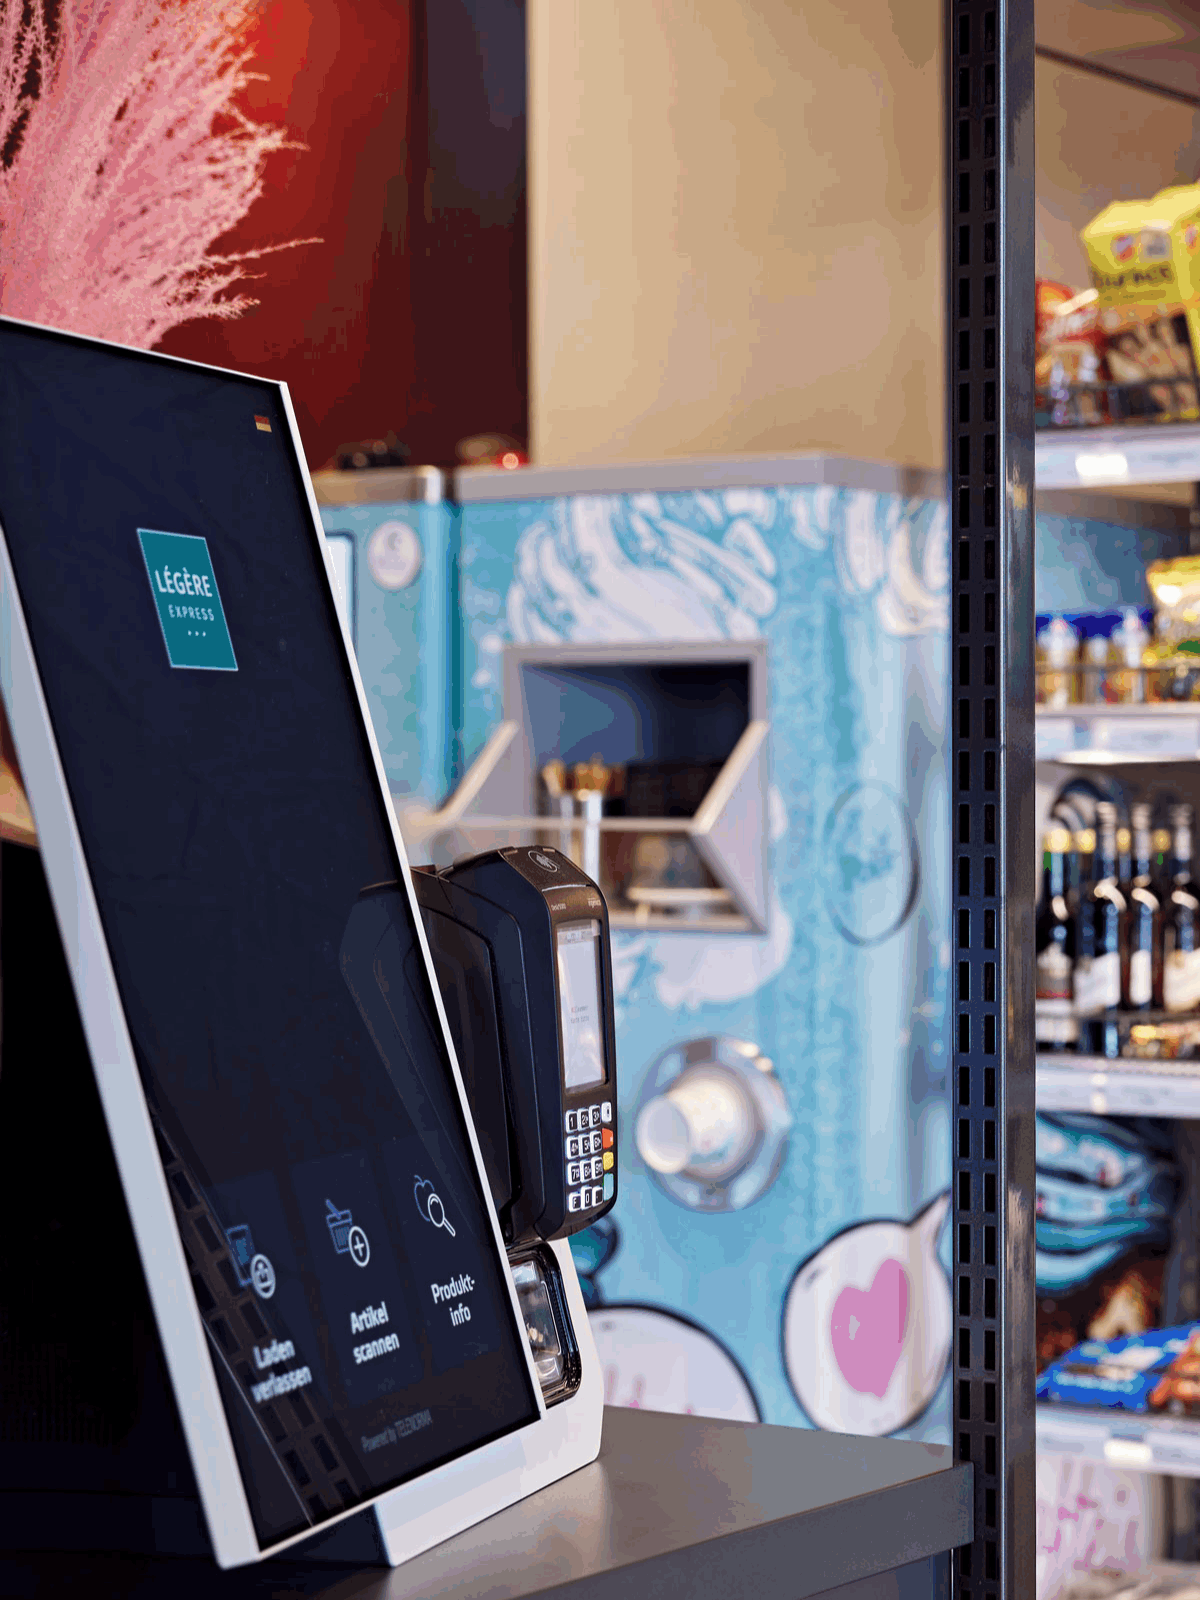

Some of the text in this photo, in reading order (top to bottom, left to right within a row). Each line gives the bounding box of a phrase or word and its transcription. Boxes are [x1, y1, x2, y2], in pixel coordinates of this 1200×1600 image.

[155, 565, 213, 597] LÉGÈRE
[168, 604, 215, 621] EXPRESS
[431, 1273, 475, 1304] Produkt-
[350, 1300, 389, 1335] Artikel
[449, 1302, 472, 1327] info
[252, 1338, 296, 1370] Laden
[353, 1332, 400, 1365] scannen
[251, 1366, 312, 1404] verlassen
